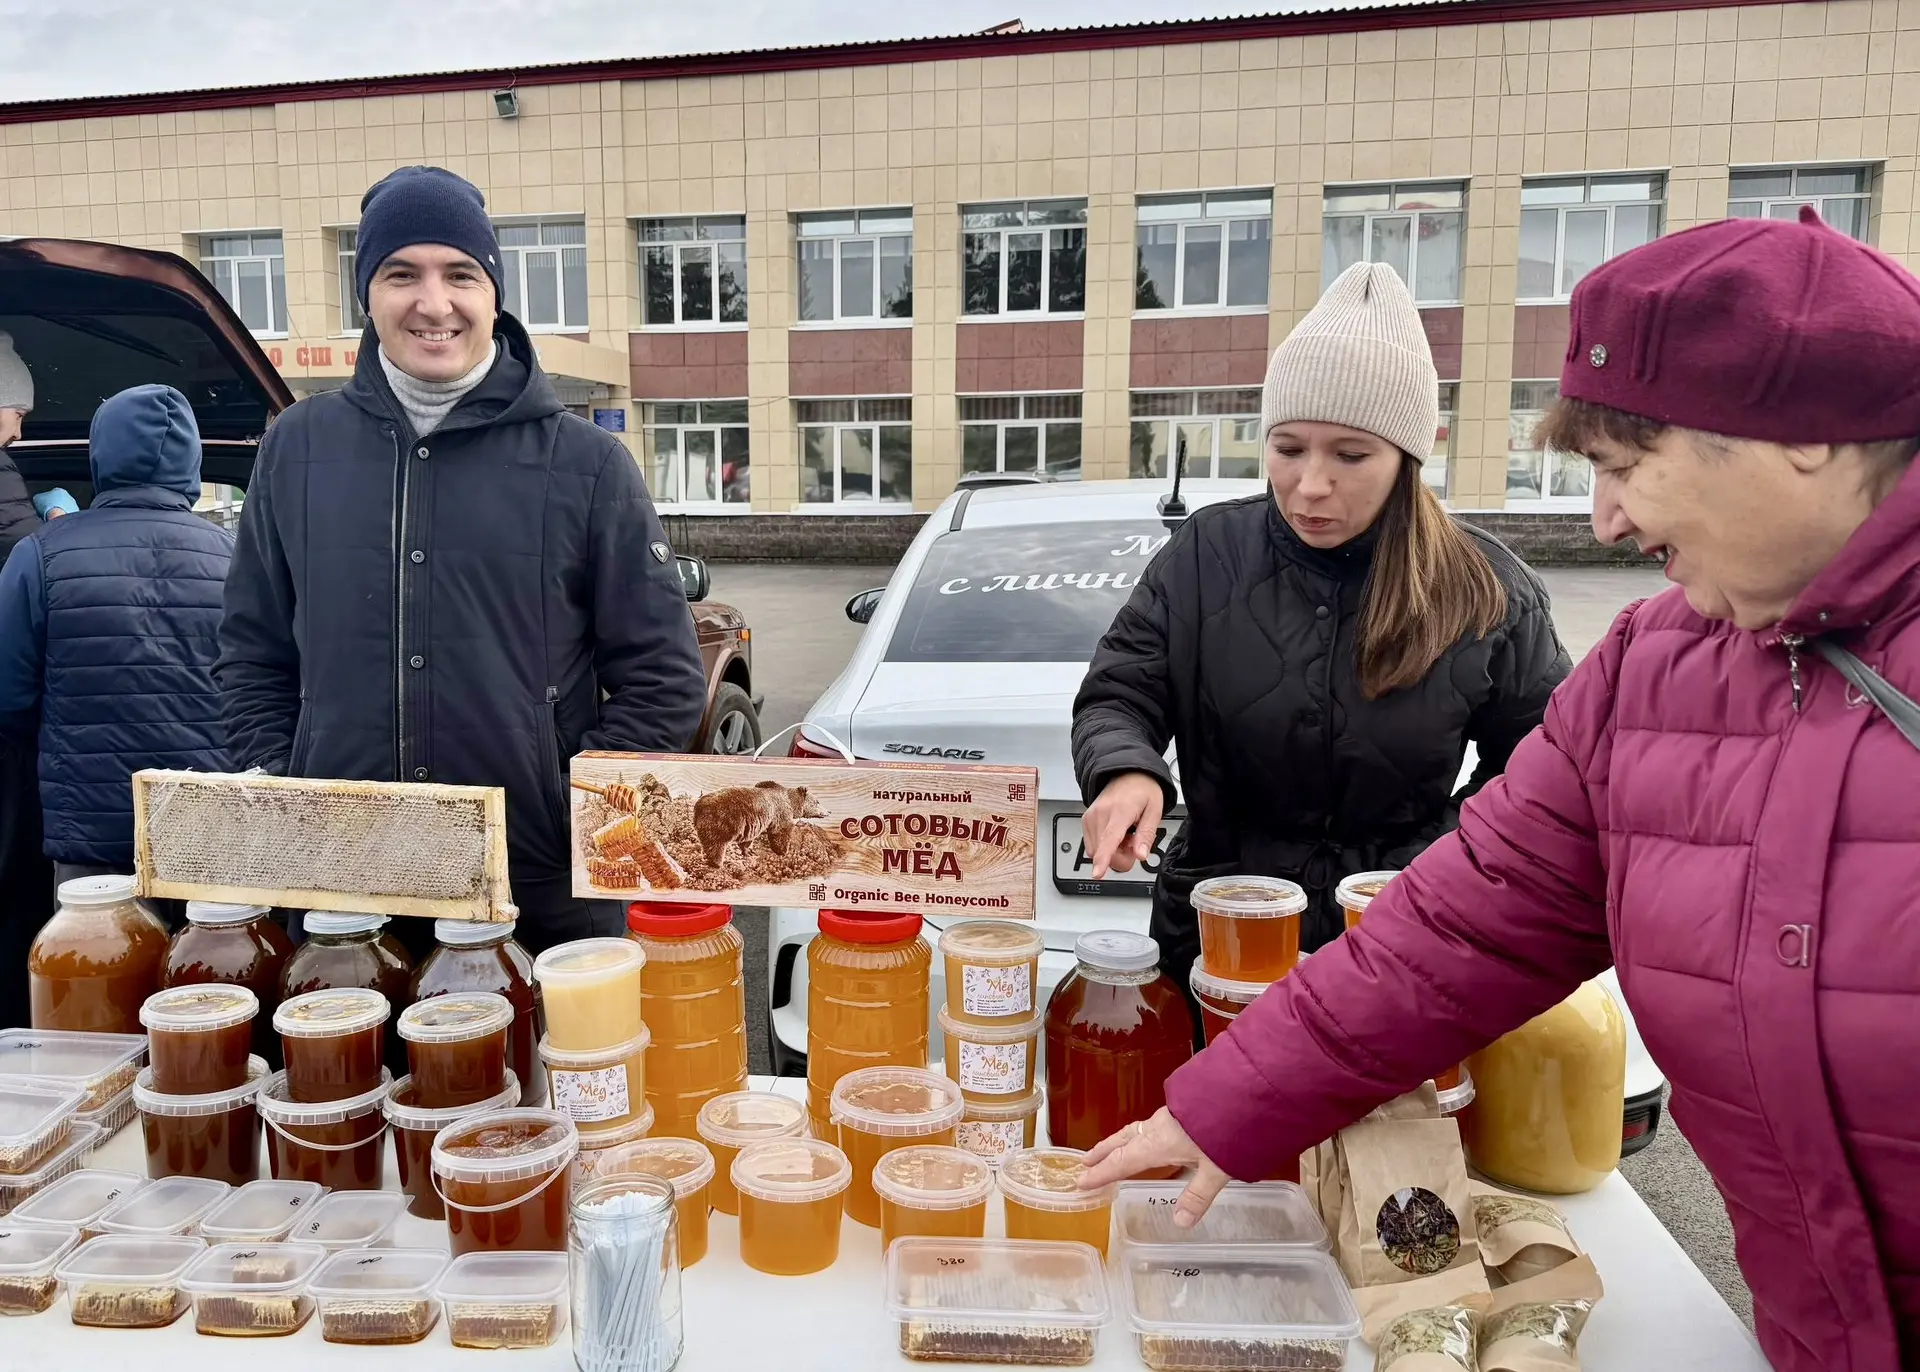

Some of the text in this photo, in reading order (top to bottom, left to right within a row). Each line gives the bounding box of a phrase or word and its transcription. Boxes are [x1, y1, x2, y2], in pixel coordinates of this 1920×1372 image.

[297, 347, 332, 366] СШ
[883, 743, 984, 760] SOLARIS
[873, 790, 972, 804] натуральный
[840, 814, 1008, 847] СОТОВЫЙ
[881, 841, 963, 881] МЁД
[834, 888, 1009, 908] Organic Bee Honeycomb
